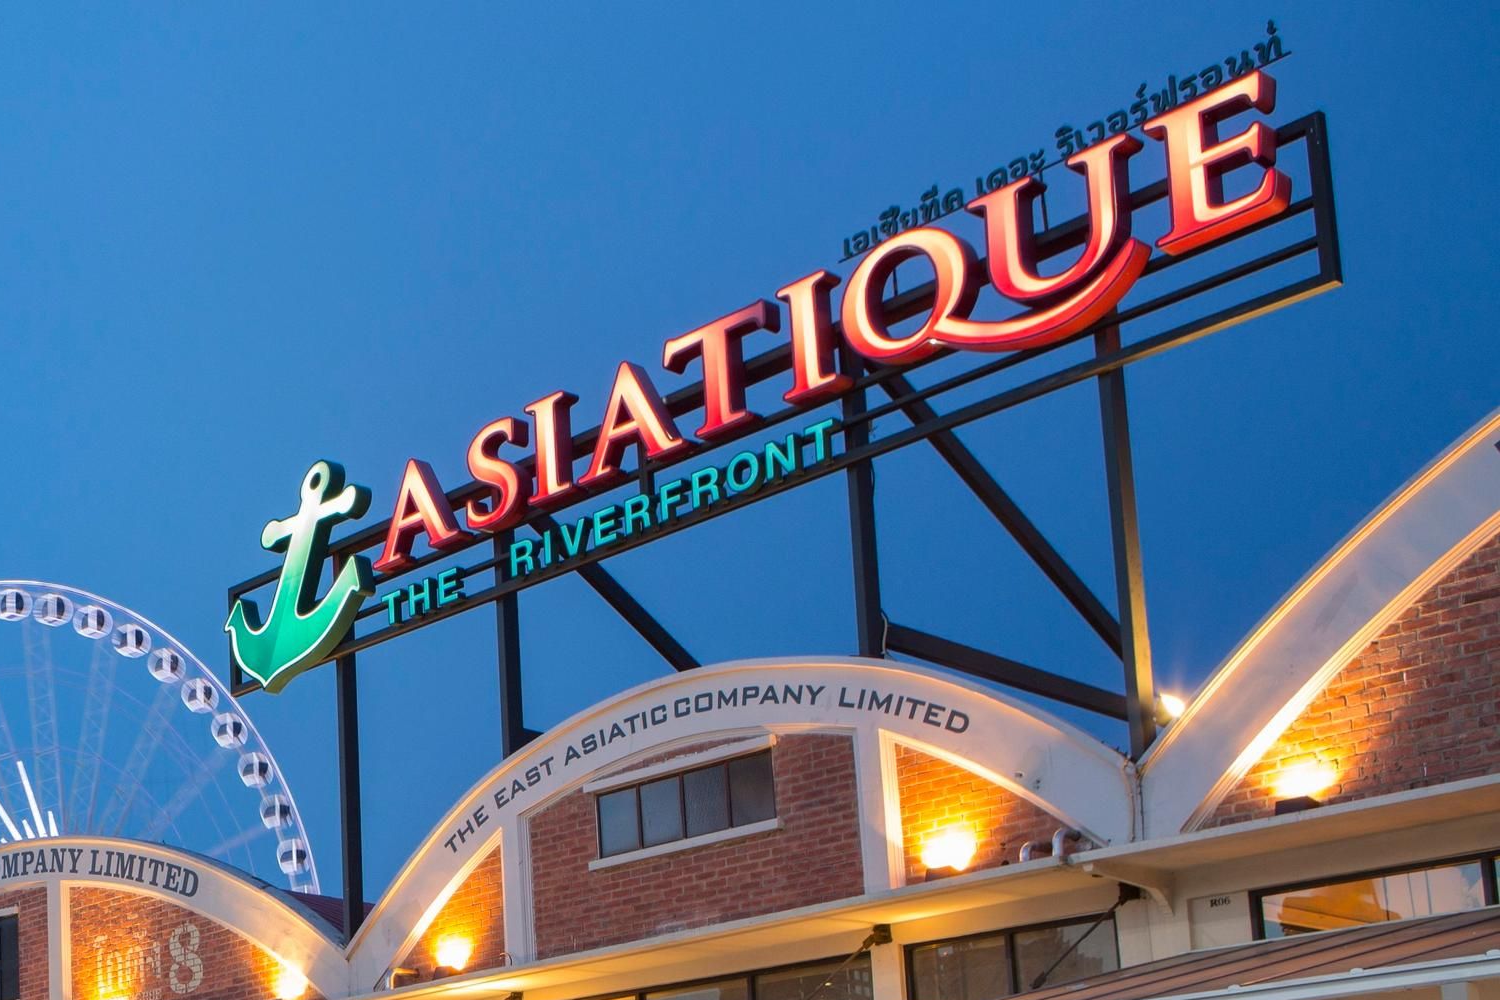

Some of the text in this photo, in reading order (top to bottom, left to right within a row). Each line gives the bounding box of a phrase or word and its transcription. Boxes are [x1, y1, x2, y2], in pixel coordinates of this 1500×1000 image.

[374, 70, 1292, 574] ASIATIQUE
[381, 416, 844, 626] THE RIVERFRONT
[443, 683, 971, 854] THE EAST ASIATIC COMPANY LIMITED
[88, 849, 200, 898] LIMITED
[168, 920, 204, 994] 8
